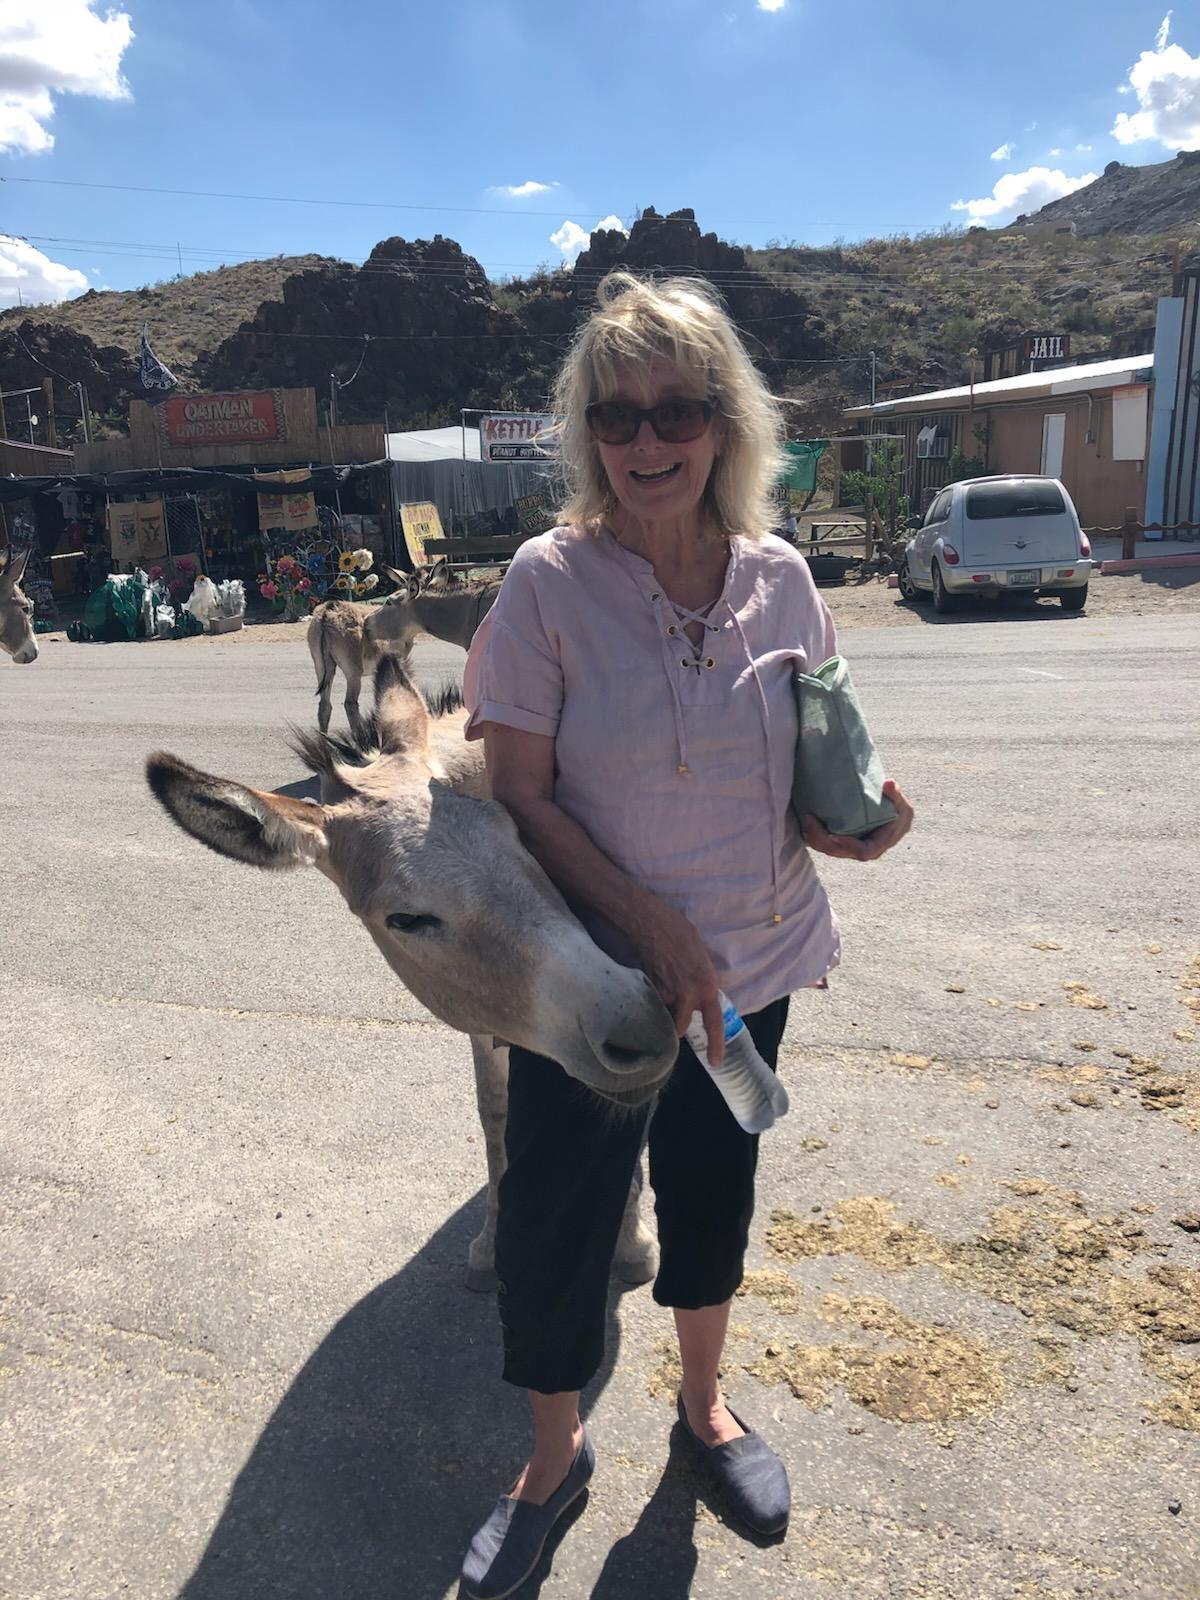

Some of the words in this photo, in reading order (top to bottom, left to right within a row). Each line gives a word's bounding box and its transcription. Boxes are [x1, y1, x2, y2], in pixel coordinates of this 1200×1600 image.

[1030, 336, 1064, 358] JAIL
[184, 399, 254, 421] OATMAN
[176, 418, 269, 438] UNDERTAKER
[486, 419, 546, 441] KETTLE
[492, 447, 517, 456] PEANUT
[516, 494, 544, 511] BURRO
